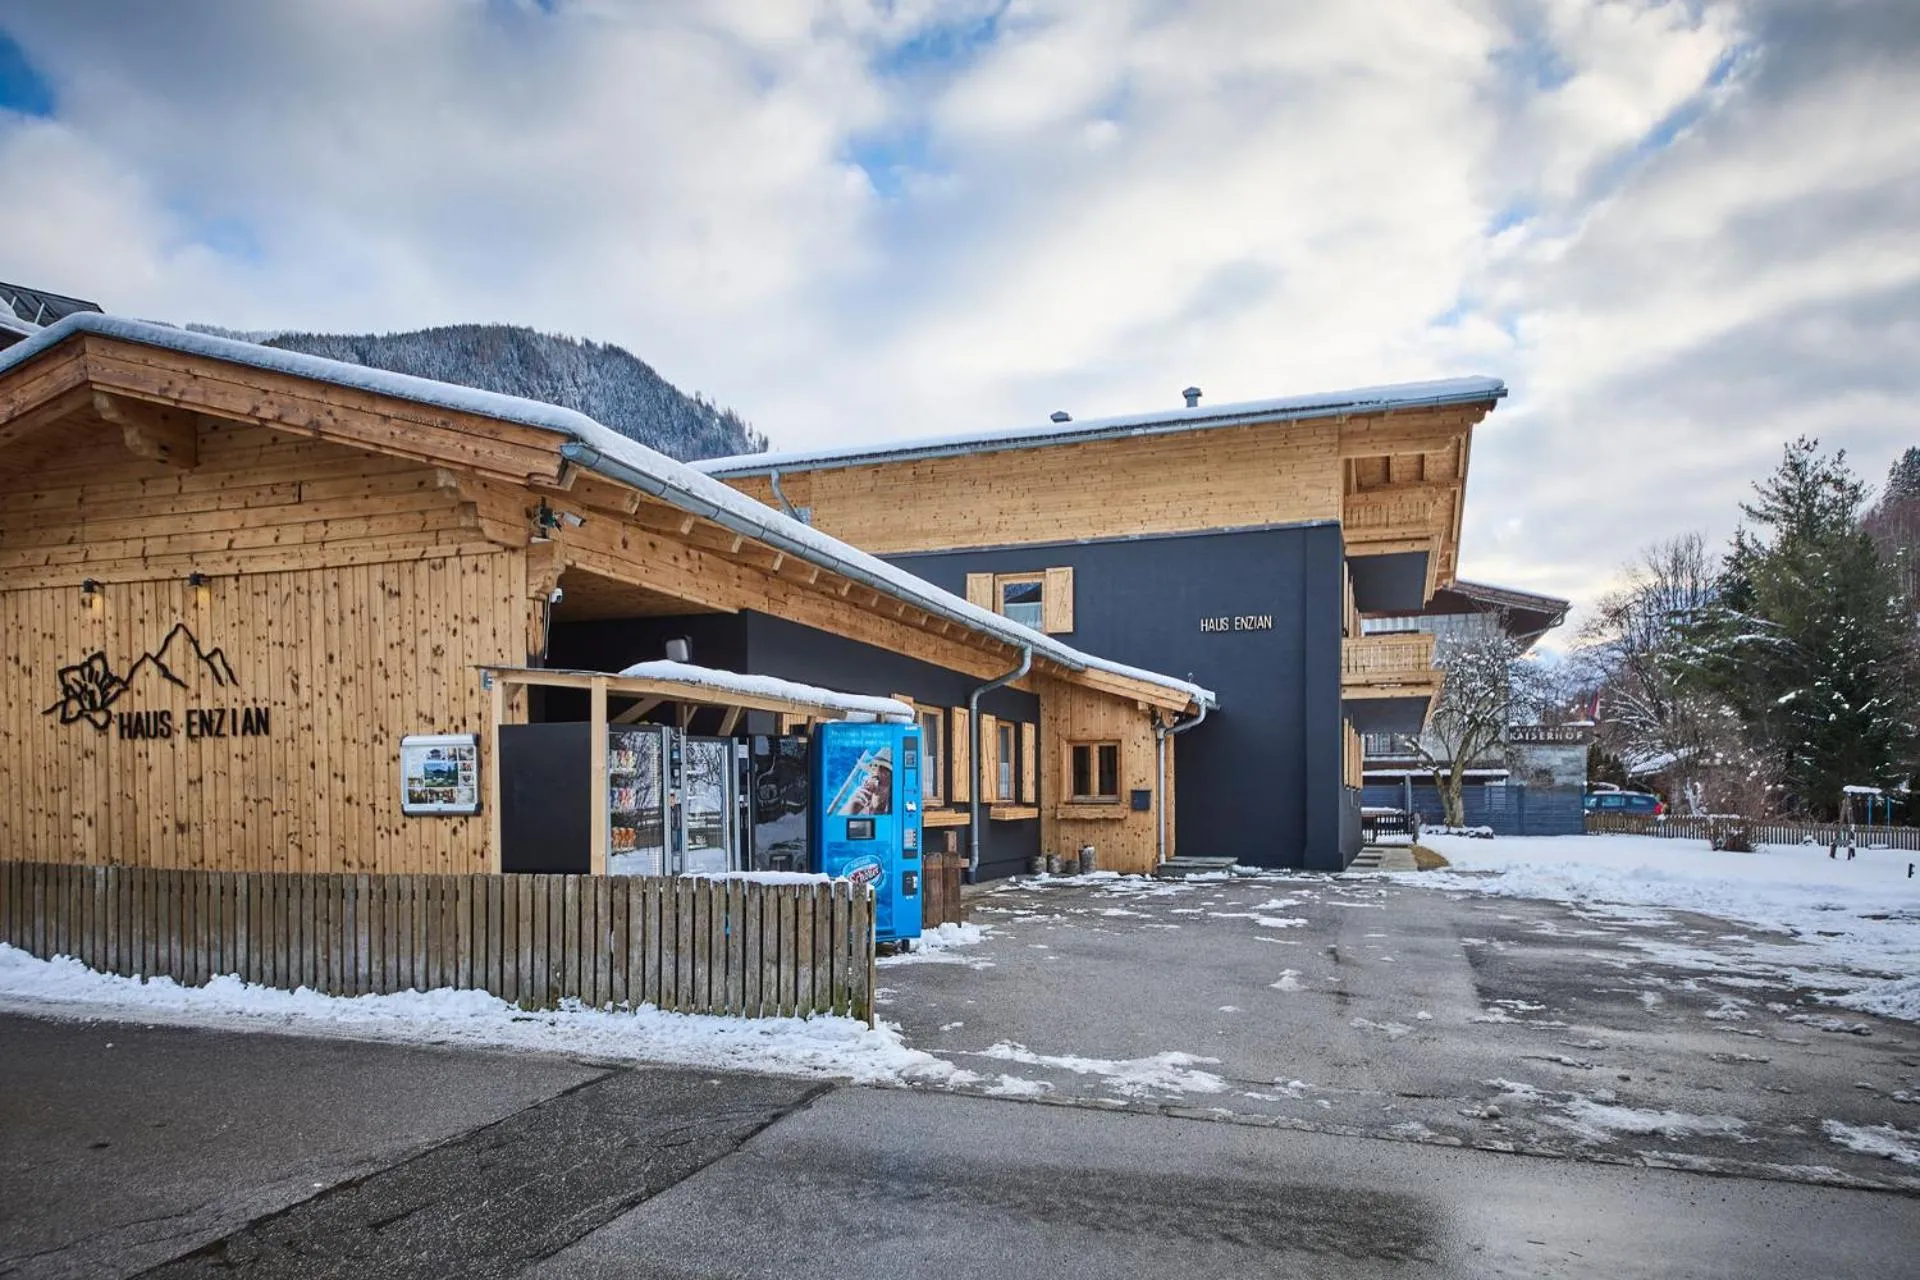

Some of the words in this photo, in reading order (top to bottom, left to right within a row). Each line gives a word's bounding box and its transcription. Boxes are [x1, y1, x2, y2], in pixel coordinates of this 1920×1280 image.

[1200, 617, 1229, 631] HAUS
[1234, 615, 1272, 630] ENZIAN
[119, 710, 172, 739] HAUS
[186, 707, 270, 738] ENZIAN
[1509, 730, 1583, 741] KAISERHOF
